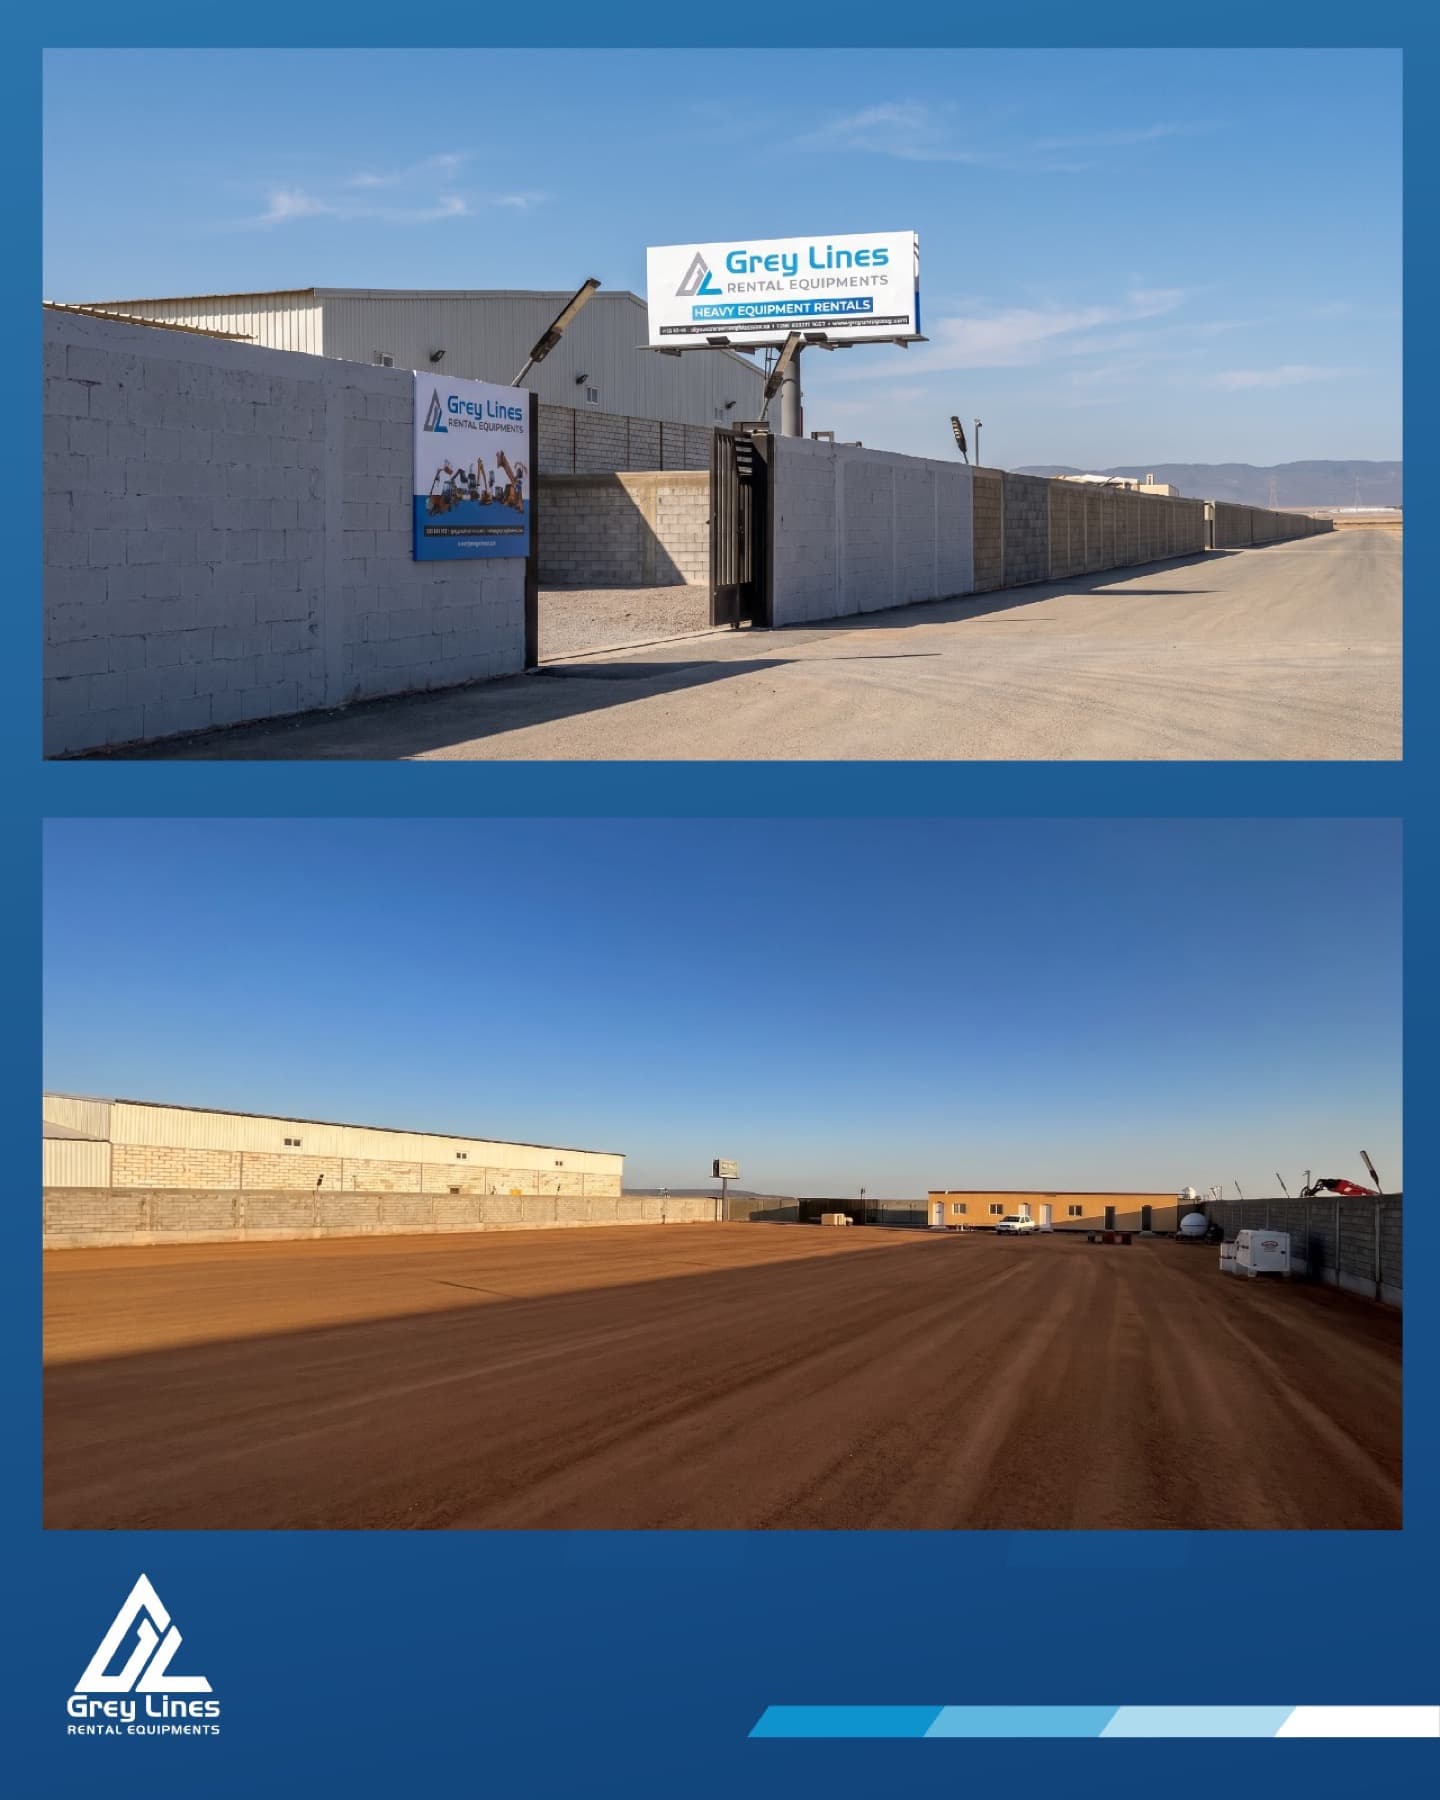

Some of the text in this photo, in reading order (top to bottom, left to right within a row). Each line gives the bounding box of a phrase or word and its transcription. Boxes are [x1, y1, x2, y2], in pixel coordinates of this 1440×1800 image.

[726, 245, 889, 277] Grey Lines
[727, 275, 889, 294] RENTAL EQUIPMENTS
[694, 299, 871, 318] HEAVY EQUIPMENT RENTALS
[447, 395, 522, 421] Grey Lines
[448, 418, 524, 434] RENTAL EQUIPMENTS
